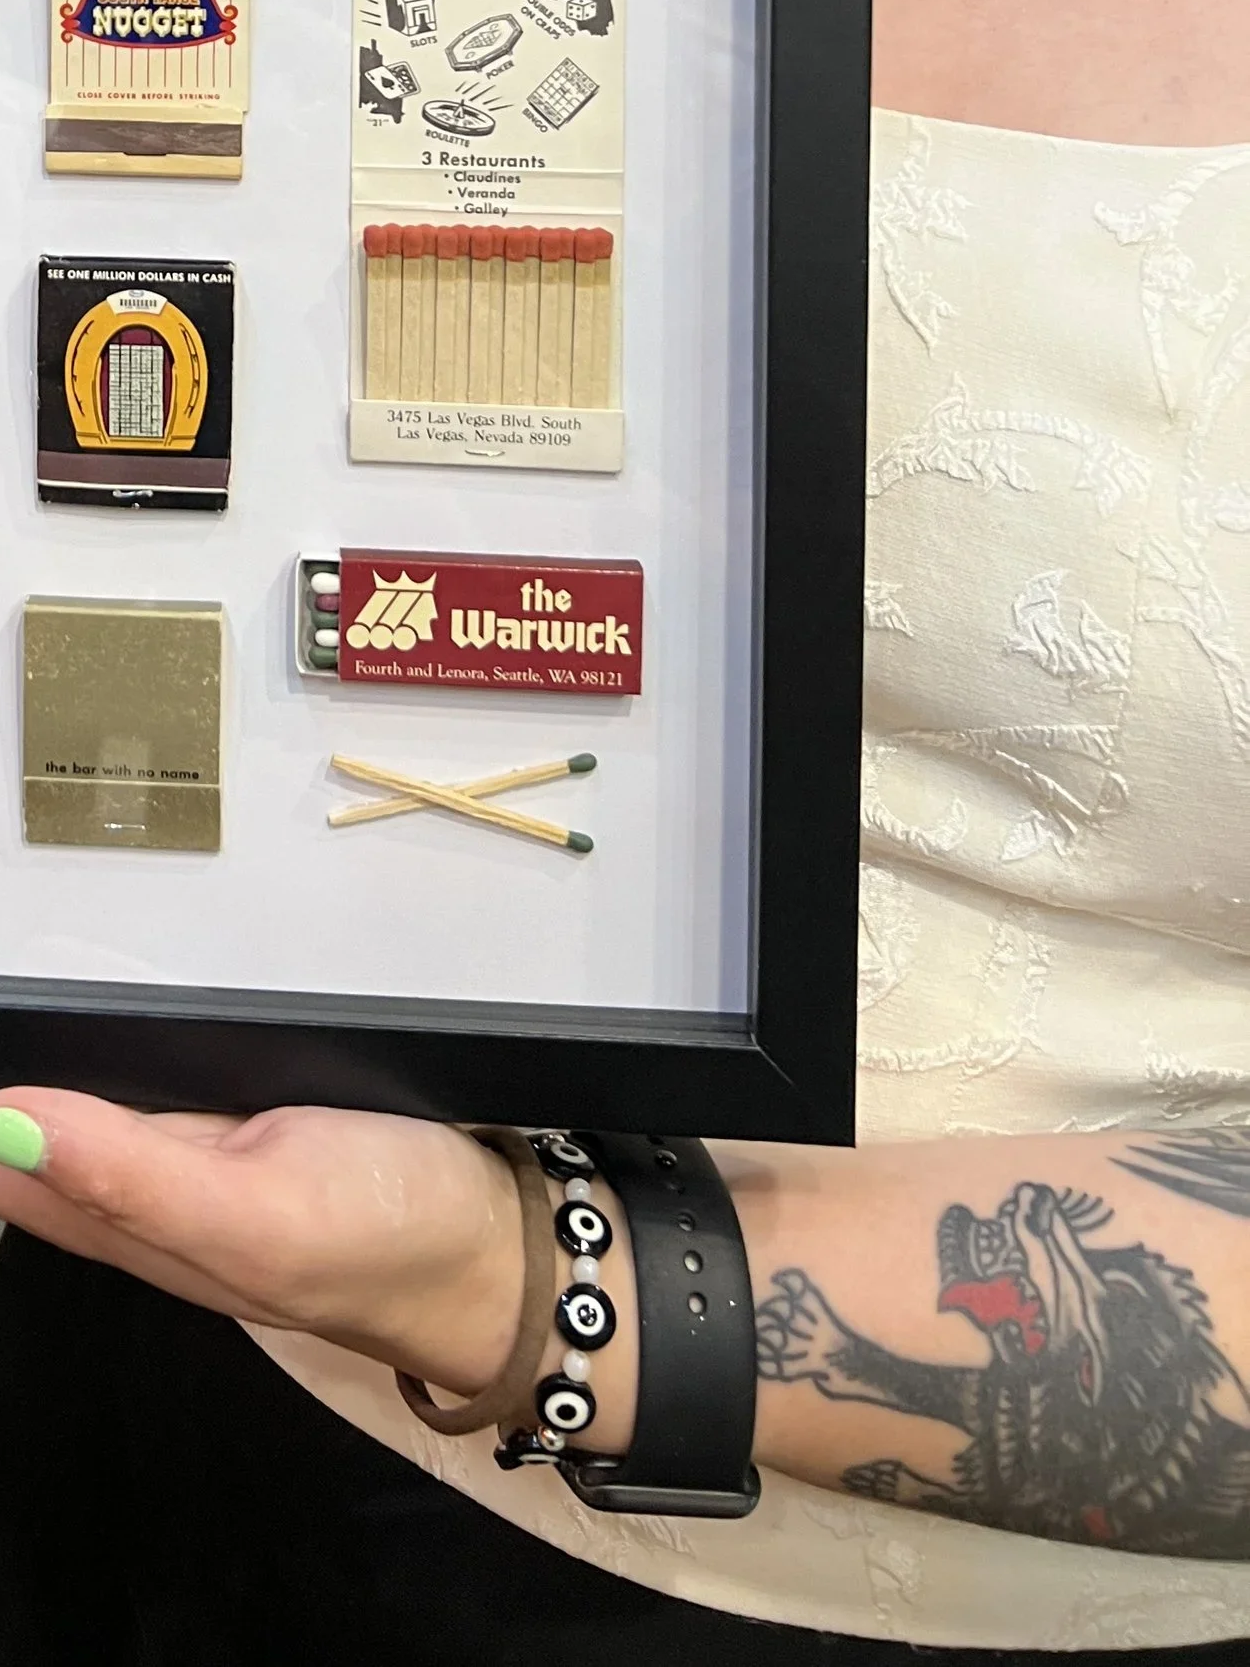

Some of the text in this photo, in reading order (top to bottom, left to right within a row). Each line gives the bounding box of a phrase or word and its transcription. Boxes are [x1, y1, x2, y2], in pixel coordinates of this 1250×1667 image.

[92, 6, 207, 37] NUGGET
[410, 35, 438, 48] SLOTS
[486, 59, 515, 80] POKER
[77, 91, 102, 99] CLOSE
[141, 92, 173, 100] BEFORE
[179, 92, 220, 100] STRIKING
[425, 129, 471, 148] ROULETTE
[421, 151, 546, 168] 3 Restaurants
[453, 171, 521, 184] Claudines
[457, 187, 516, 200] Veranda
[463, 203, 509, 218] Galley
[47, 269, 232, 284] SEE ONE MILLION DOLLARS IN CASH
[387, 410, 582, 431] 3475 Las Vegas Blvd. South
[397, 426, 572, 446] Las Vegas, Nevada 89109
[520, 578, 573, 613] the
[450, 609, 632, 655] Warwick
[354, 660, 623, 686] Fourth and Lenora, Seattle, WA 98121
[45, 761, 200, 780] the bar with no name
